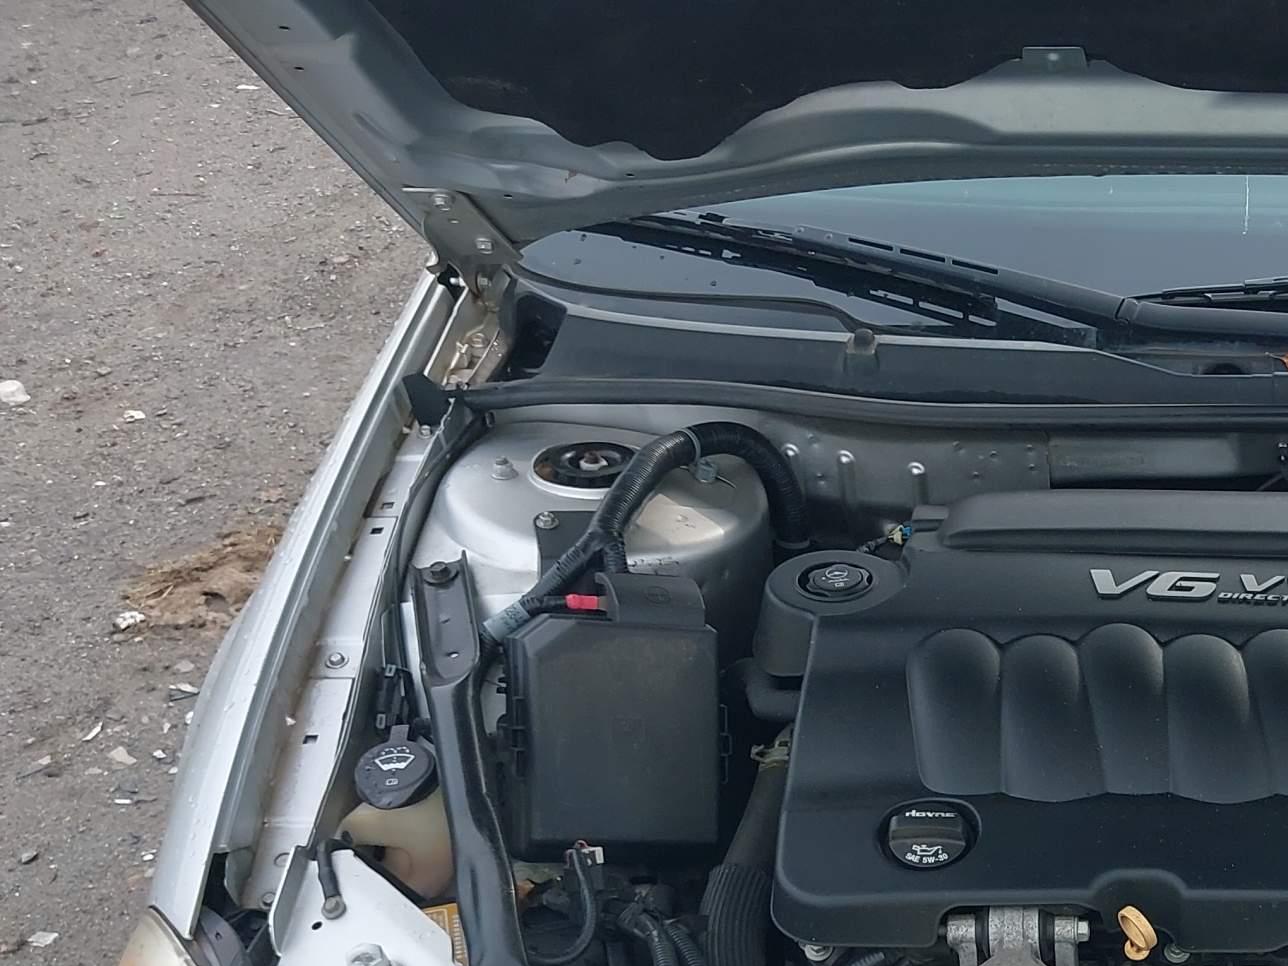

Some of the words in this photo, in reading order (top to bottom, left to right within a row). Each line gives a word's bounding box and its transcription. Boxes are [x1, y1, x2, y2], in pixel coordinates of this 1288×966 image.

[1089, 568, 1220, 600] V6
[905, 852, 920, 863] SAE
[922, 853, 948, 863] 5W-30
